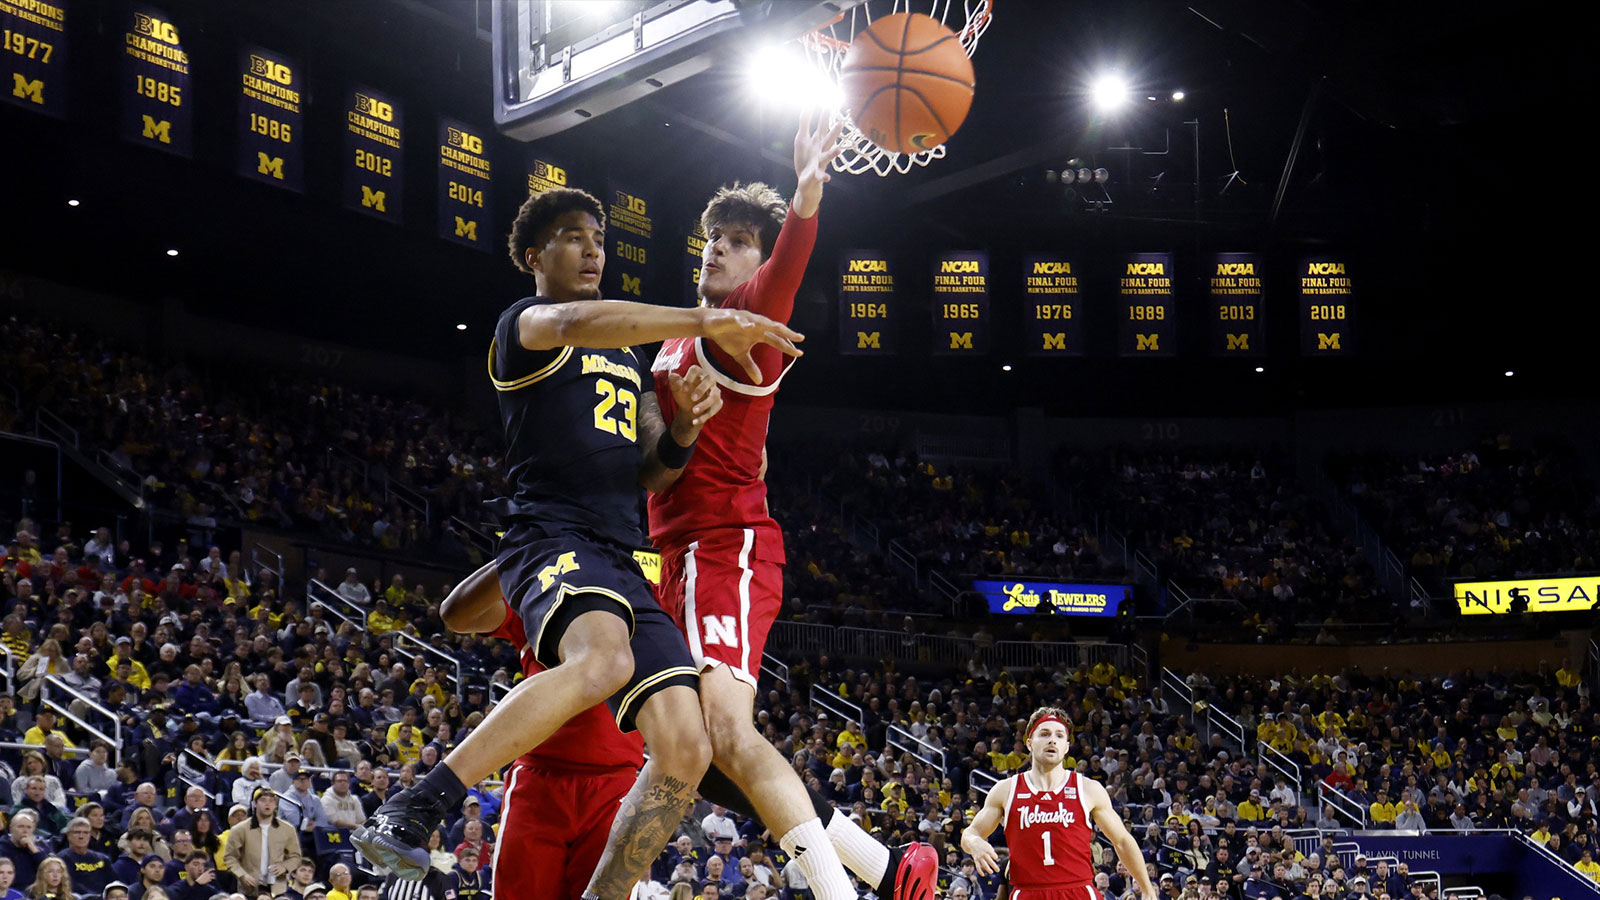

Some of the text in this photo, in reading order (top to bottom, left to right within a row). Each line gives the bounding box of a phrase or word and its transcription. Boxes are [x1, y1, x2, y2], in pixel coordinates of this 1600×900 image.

[18, 9, 64, 32] BASKETBALL
[4, 30, 53, 64] 1977
[126, 32, 189, 64] CHAMPIONS
[147, 54, 188, 74] BASKETBALL
[12, 73, 45, 104] M
[136, 74, 182, 107] 1985
[243, 74, 300, 104] CHAMPIONS
[262, 94, 300, 114] BASKETBALL
[142, 114, 170, 144] M
[250, 112, 292, 143] 1986
[348, 111, 400, 140] CHAMPIONS
[366, 129, 400, 150] BASKETBALL
[258, 152, 284, 180] M
[355, 148, 392, 178] 2012
[441, 145, 490, 172] CHAMPIONS
[458, 163, 490, 181] BASKETBALL
[361, 185, 386, 212] M
[448, 181, 484, 208] 2014
[454, 216, 478, 241] M
[609, 210, 652, 231] CHAMPIONS
[616, 240, 646, 265] 2018
[849, 260, 888, 272] NCAA
[941, 261, 979, 273] NCAA
[1033, 262, 1071, 274] NCAA
[1126, 264, 1164, 275] NCAA
[1217, 264, 1254, 275] NCAA
[1308, 263, 1346, 274] NCAA
[621, 272, 642, 296] M
[842, 274, 894, 285] FINAL FOUR
[934, 276, 986, 286] FINAL FOUR
[1028, 277, 1078, 286] FINAL FOUR
[1120, 278, 1171, 287] FINAL FOUR
[1210, 278, 1261, 287] FINAL FOUR
[1302, 278, 1352, 287] FINAL FOUR
[850, 303, 887, 318] 1964
[944, 304, 979, 318] 1965
[1036, 304, 1072, 320] 1976
[1130, 306, 1164, 320] 1989
[1220, 306, 1254, 320] 2013
[1310, 305, 1346, 320] 2018
[857, 332, 880, 348] M
[950, 332, 973, 349] M
[1042, 333, 1066, 350] M
[1136, 334, 1159, 350] M
[1226, 334, 1248, 350] M
[1318, 333, 1340, 350] M
[594, 378, 638, 443] 23
[537, 551, 580, 592] M
[702, 615, 738, 648] N
[664, 776, 689, 794] WHY
[1017, 802, 1076, 830] Nebraska
[1041, 831, 1055, 866] 1
[1366, 850, 1440, 860] BLAVIN TUNNEL
